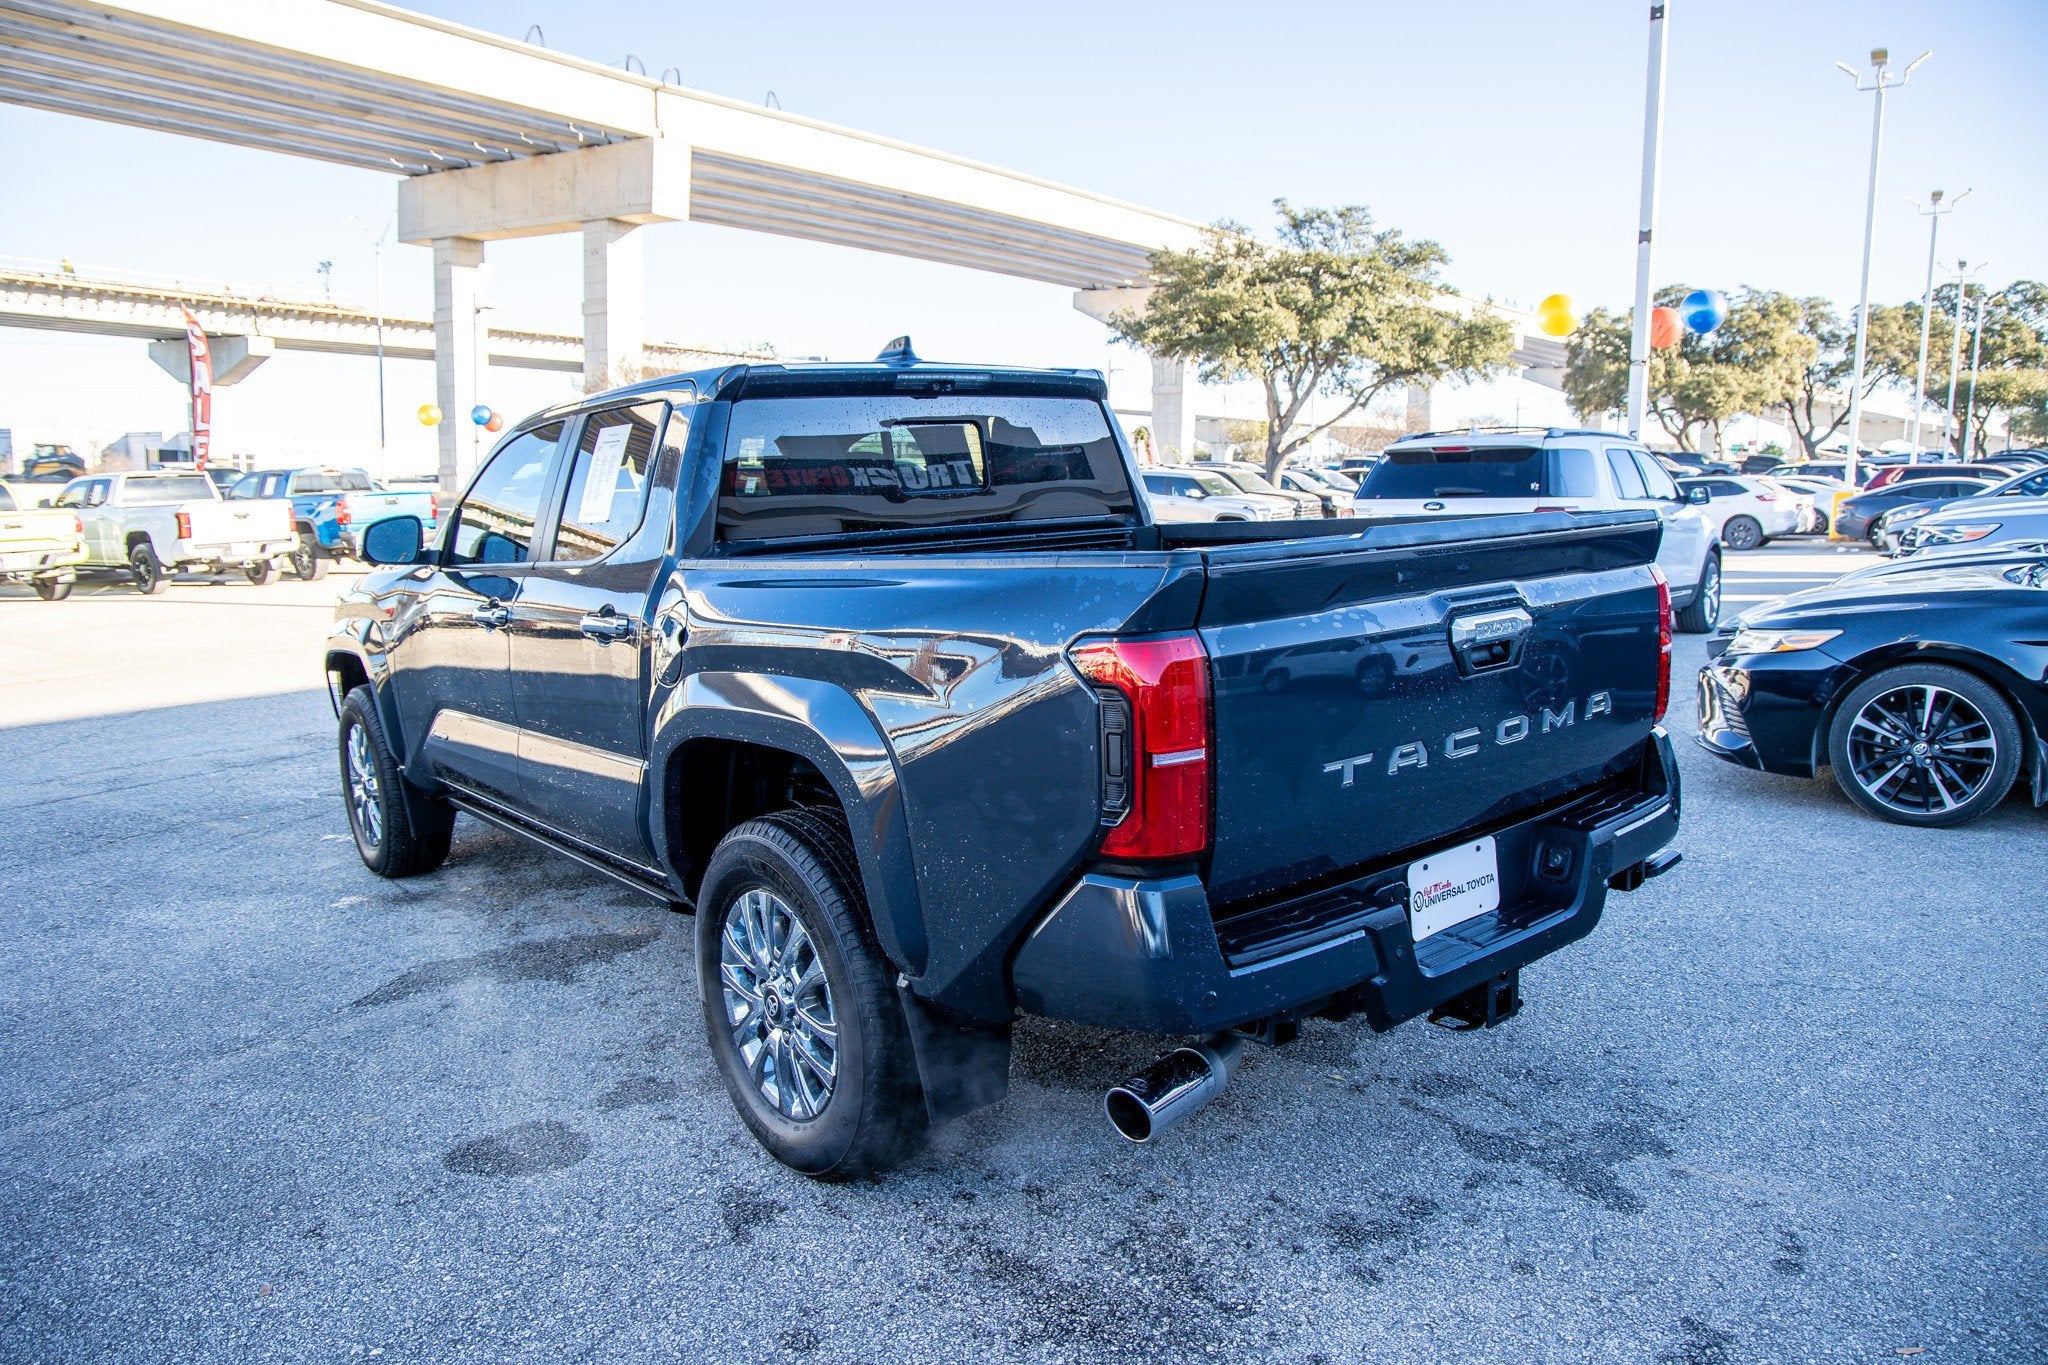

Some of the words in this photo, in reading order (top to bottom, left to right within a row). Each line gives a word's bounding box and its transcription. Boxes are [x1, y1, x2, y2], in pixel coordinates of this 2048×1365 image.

[187, 322, 211, 464] SALE
[1323, 691, 1613, 788] TACOMA
[1424, 883, 1466, 908] UNIVERSAL
[1466, 873, 1495, 891] TOYOTA
